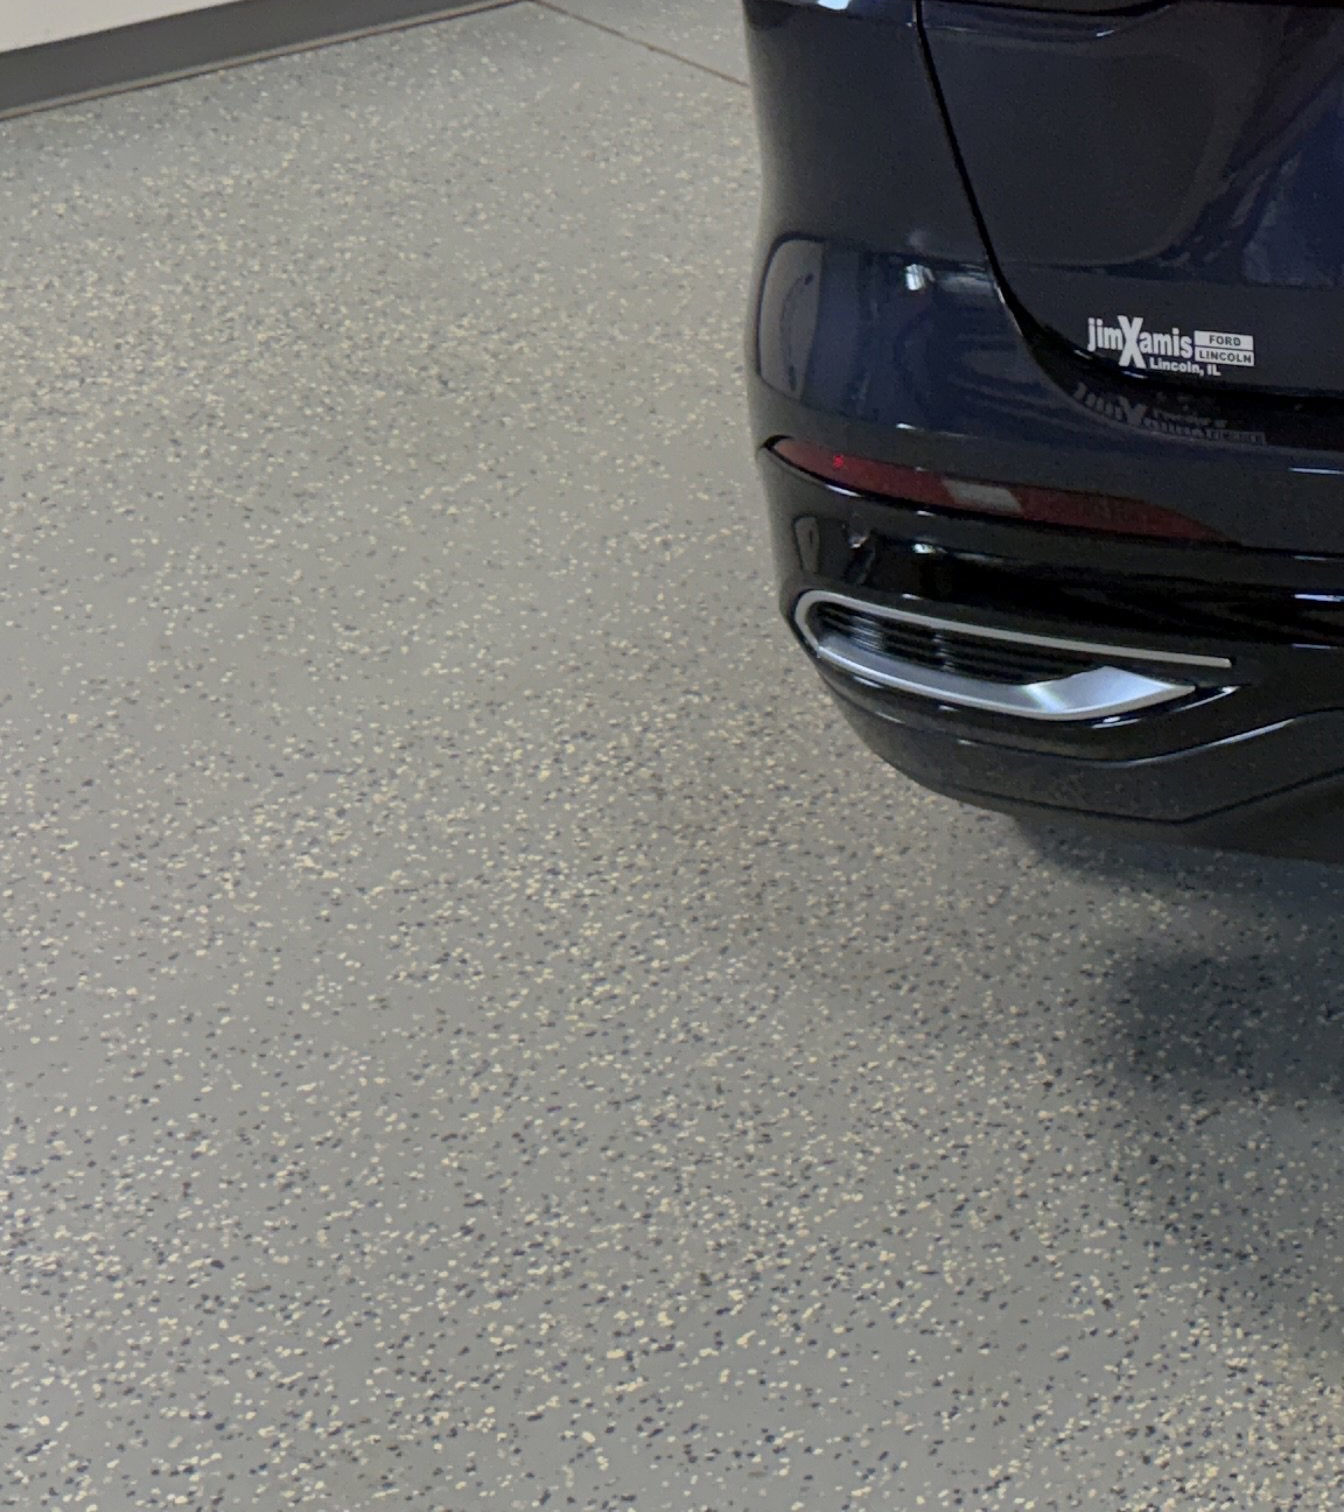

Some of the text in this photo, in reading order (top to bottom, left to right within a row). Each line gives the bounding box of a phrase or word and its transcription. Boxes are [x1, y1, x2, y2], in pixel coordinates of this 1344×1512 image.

[1087, 315, 1193, 369] jimXamis
[1209, 334, 1241, 347] FORD
[1199, 349, 1251, 364] LINCOLN
[1150, 358, 1221, 377] Lincoln, IL
